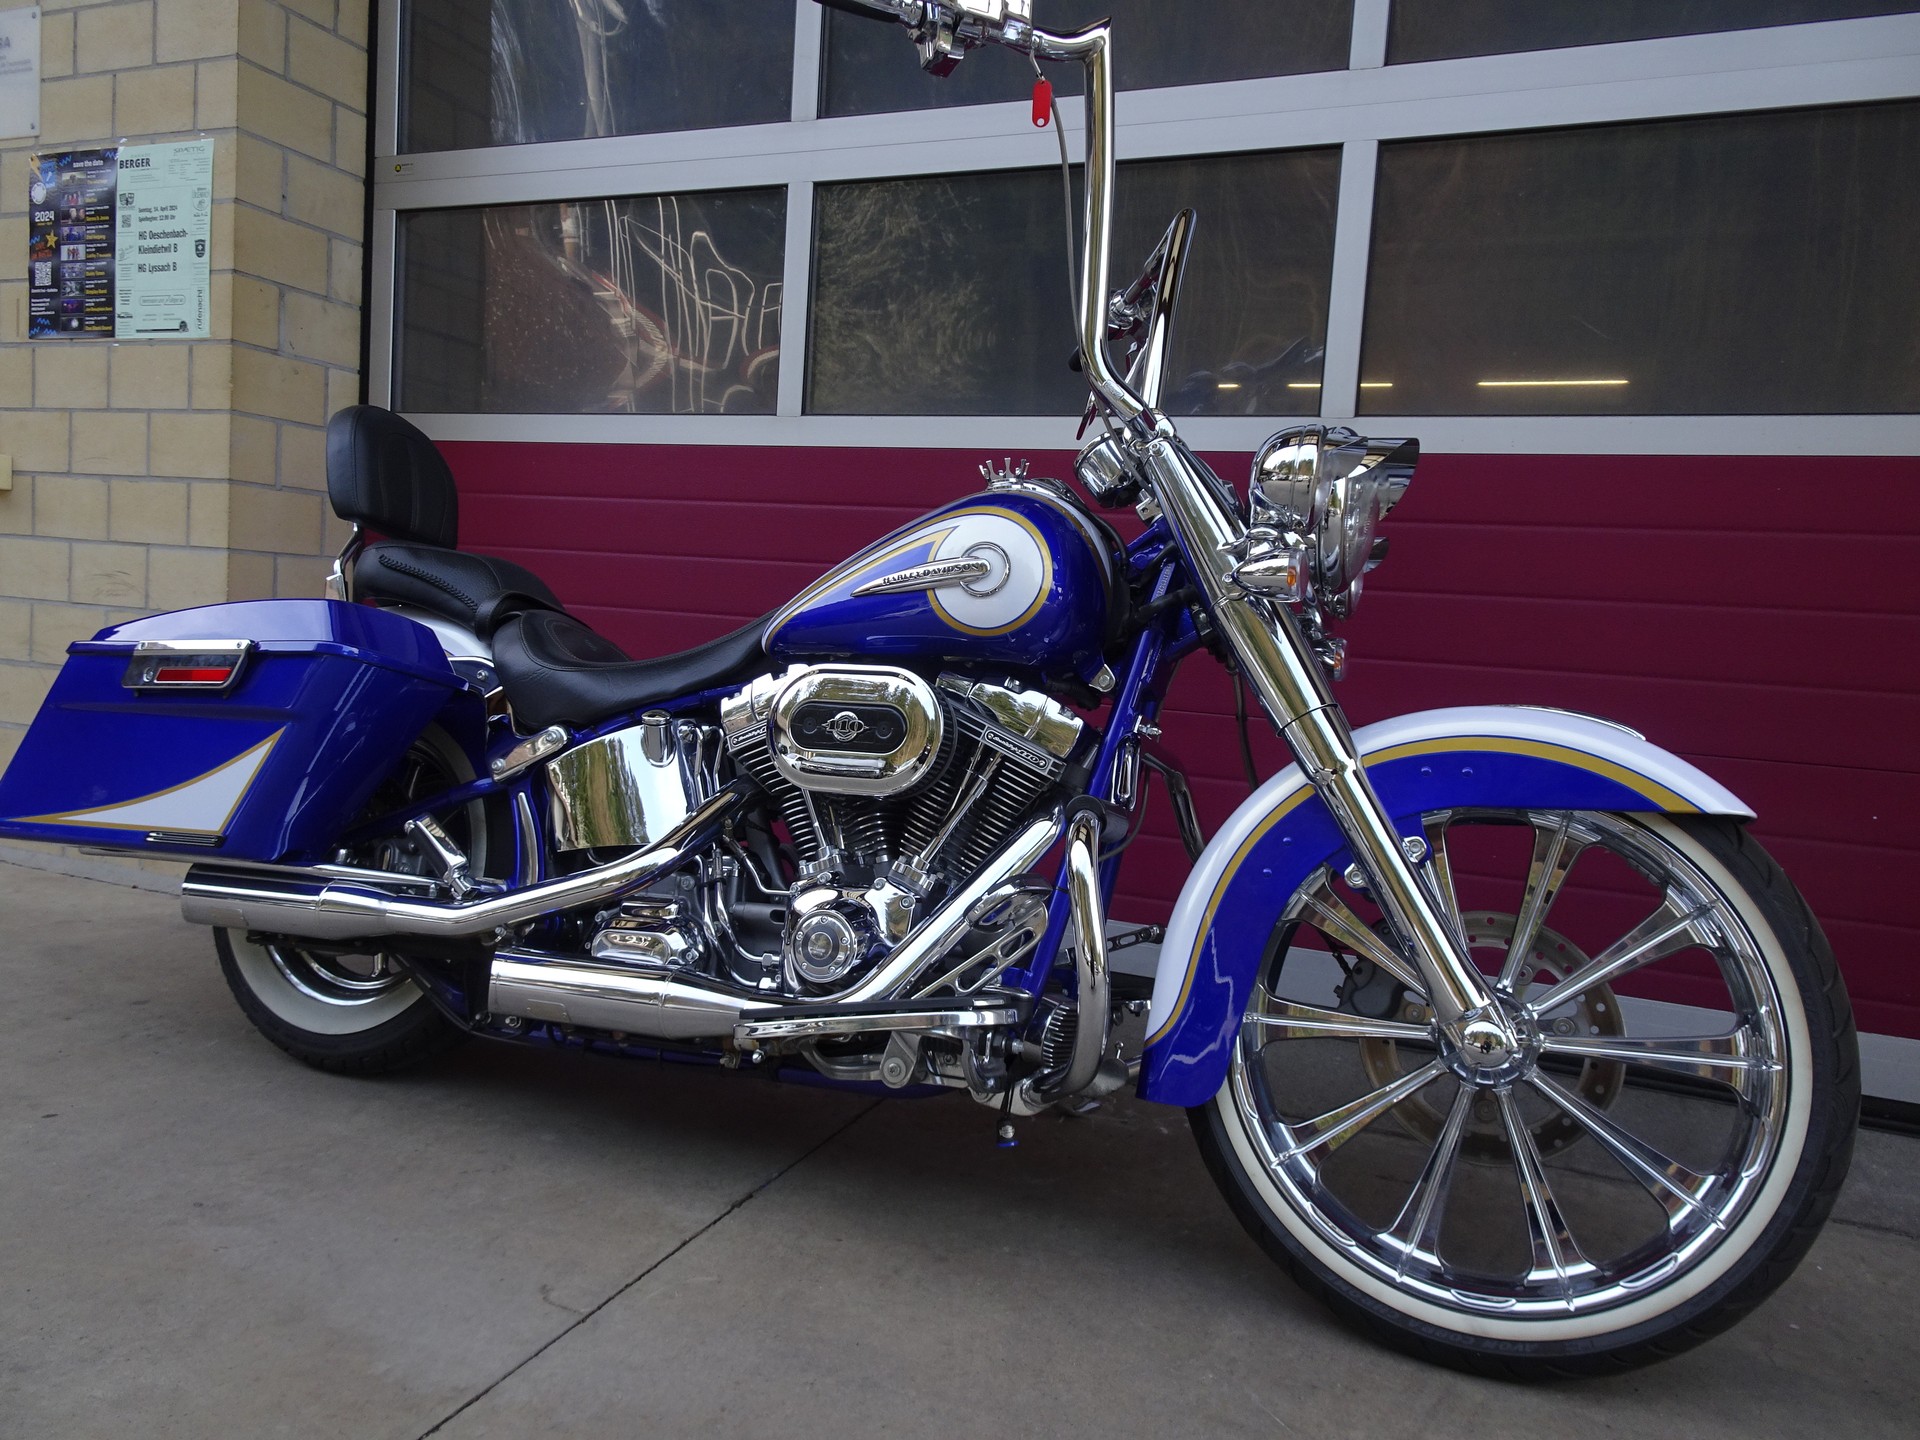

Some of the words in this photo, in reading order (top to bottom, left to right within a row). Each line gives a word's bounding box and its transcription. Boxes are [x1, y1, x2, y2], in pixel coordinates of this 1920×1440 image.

[119, 158, 151, 169] BERGER
[35, 211, 55, 222] 2024
[138, 230, 147, 240] HG
[173, 243, 178, 253] B
[137, 263, 147, 272] HG
[148, 262, 171, 274] Lyssach
[172, 262, 177, 271] B
[882, 562, 981, 585] HARLEY-DAVIDSON
